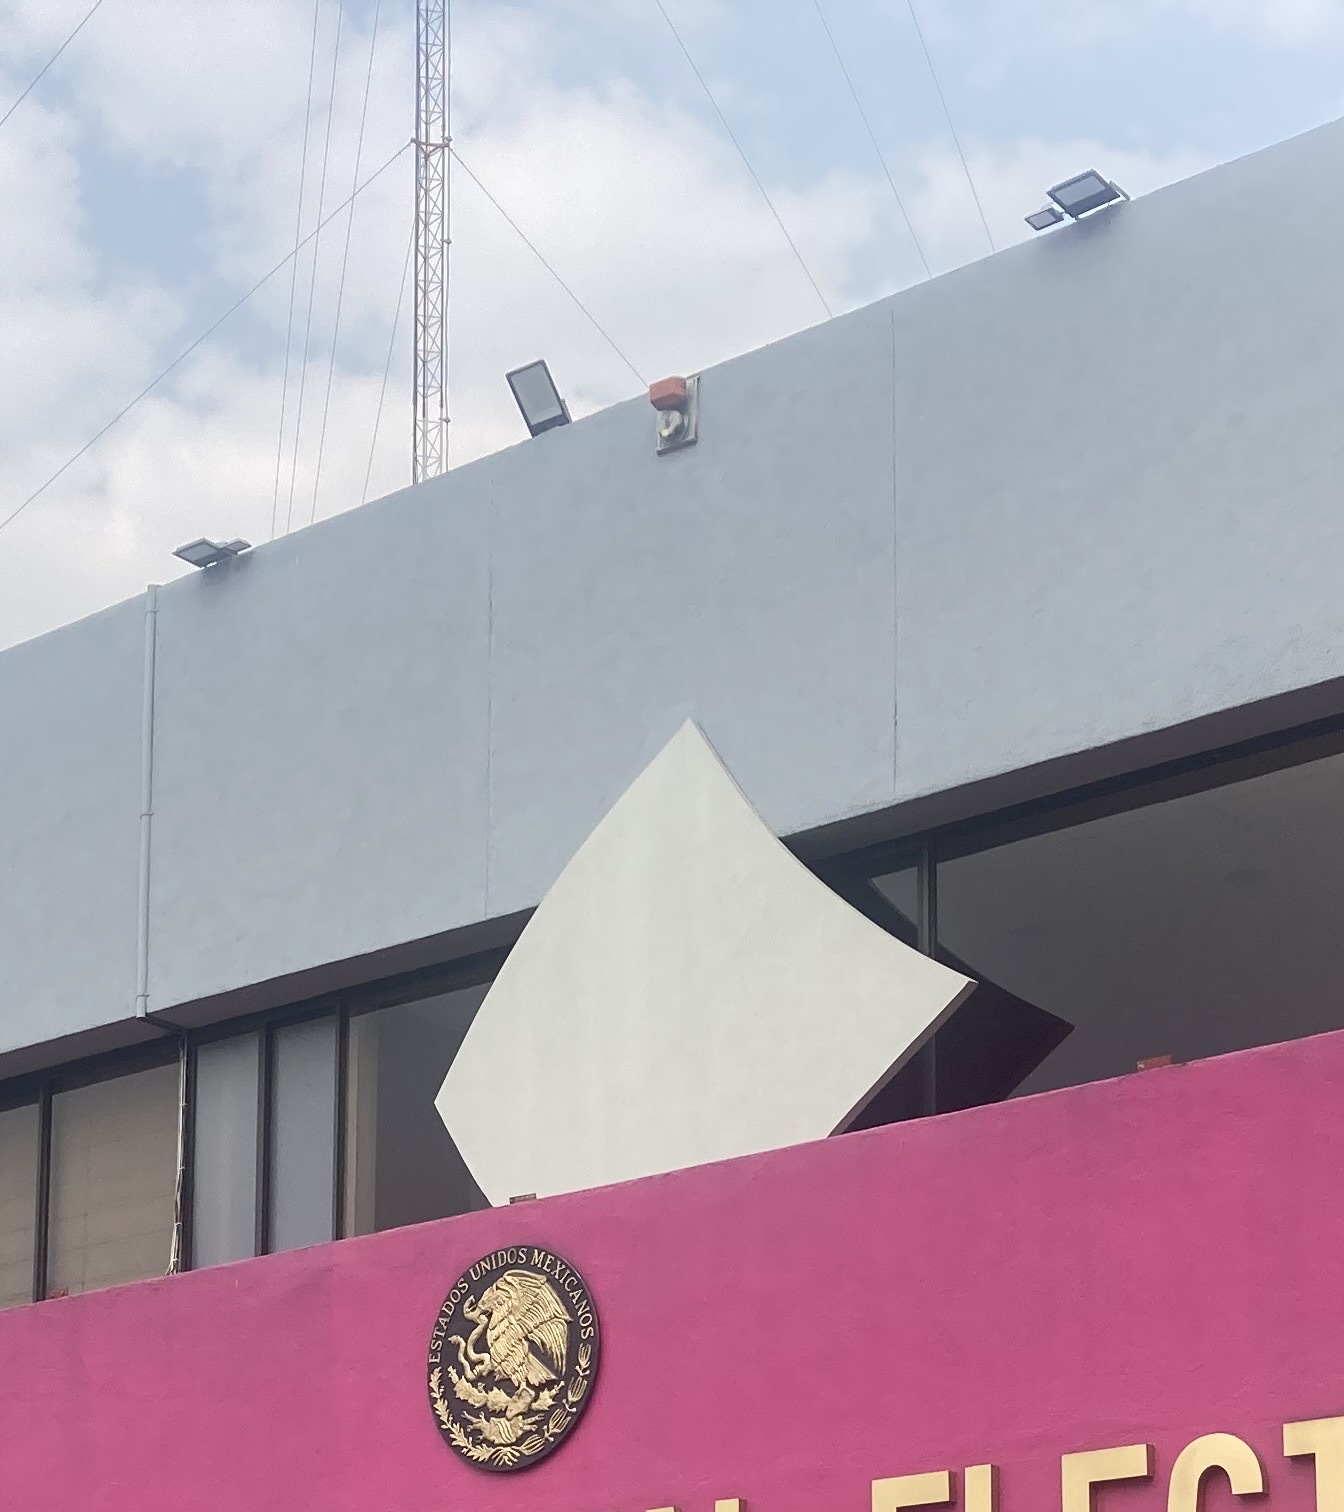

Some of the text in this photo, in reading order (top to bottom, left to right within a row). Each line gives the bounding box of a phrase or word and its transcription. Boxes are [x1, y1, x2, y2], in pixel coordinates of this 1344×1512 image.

[428, 1248, 595, 1364] ESTADOS UNIDOS MEXICANOS
